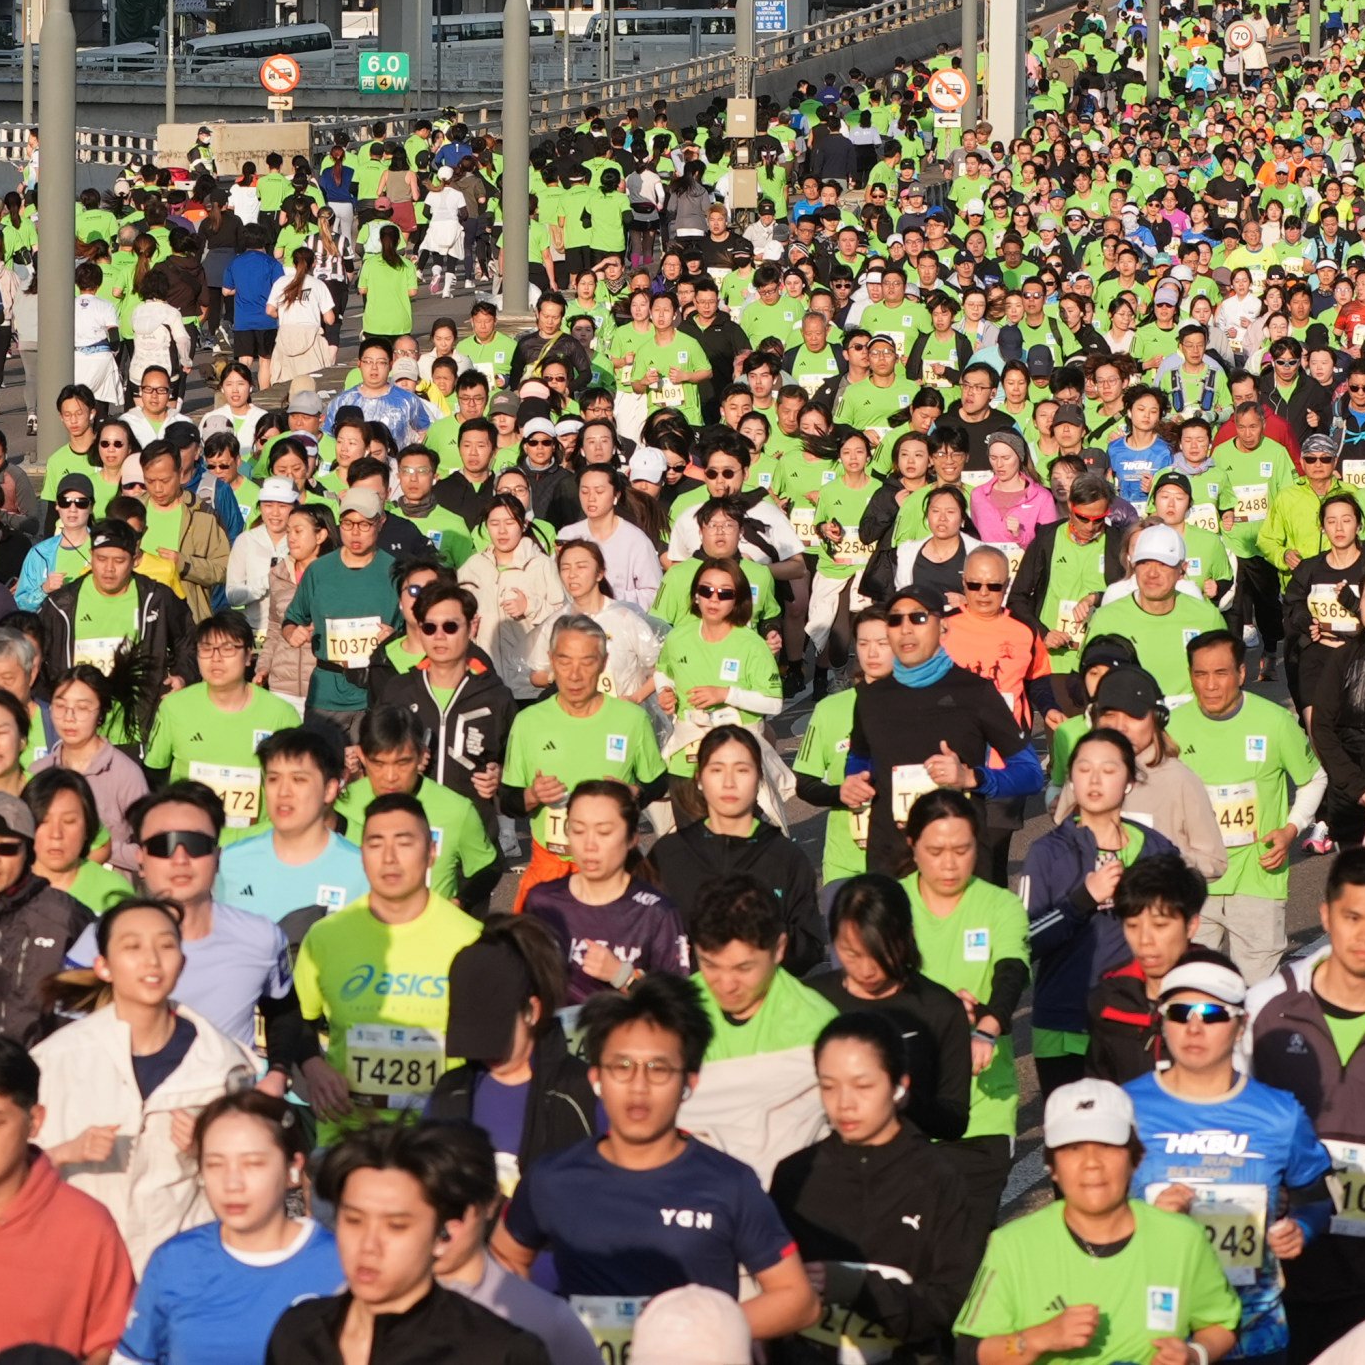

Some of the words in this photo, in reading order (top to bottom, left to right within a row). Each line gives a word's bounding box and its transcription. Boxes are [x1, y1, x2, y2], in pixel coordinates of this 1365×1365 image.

[1234, 32, 1248, 41] 70
[367, 55, 400, 73] 6.0
[379, 78, 388, 87] 4
[392, 76, 408, 90] W
[793, 523, 816, 536] T30
[835, 540, 876, 555] S2546
[329, 637, 378, 655] T0379
[1218, 805, 1255, 829] 445
[375, 972, 450, 1001] asics
[352, 1056, 438, 1087] T4281
[1166, 1134, 1247, 1155] HKBU
